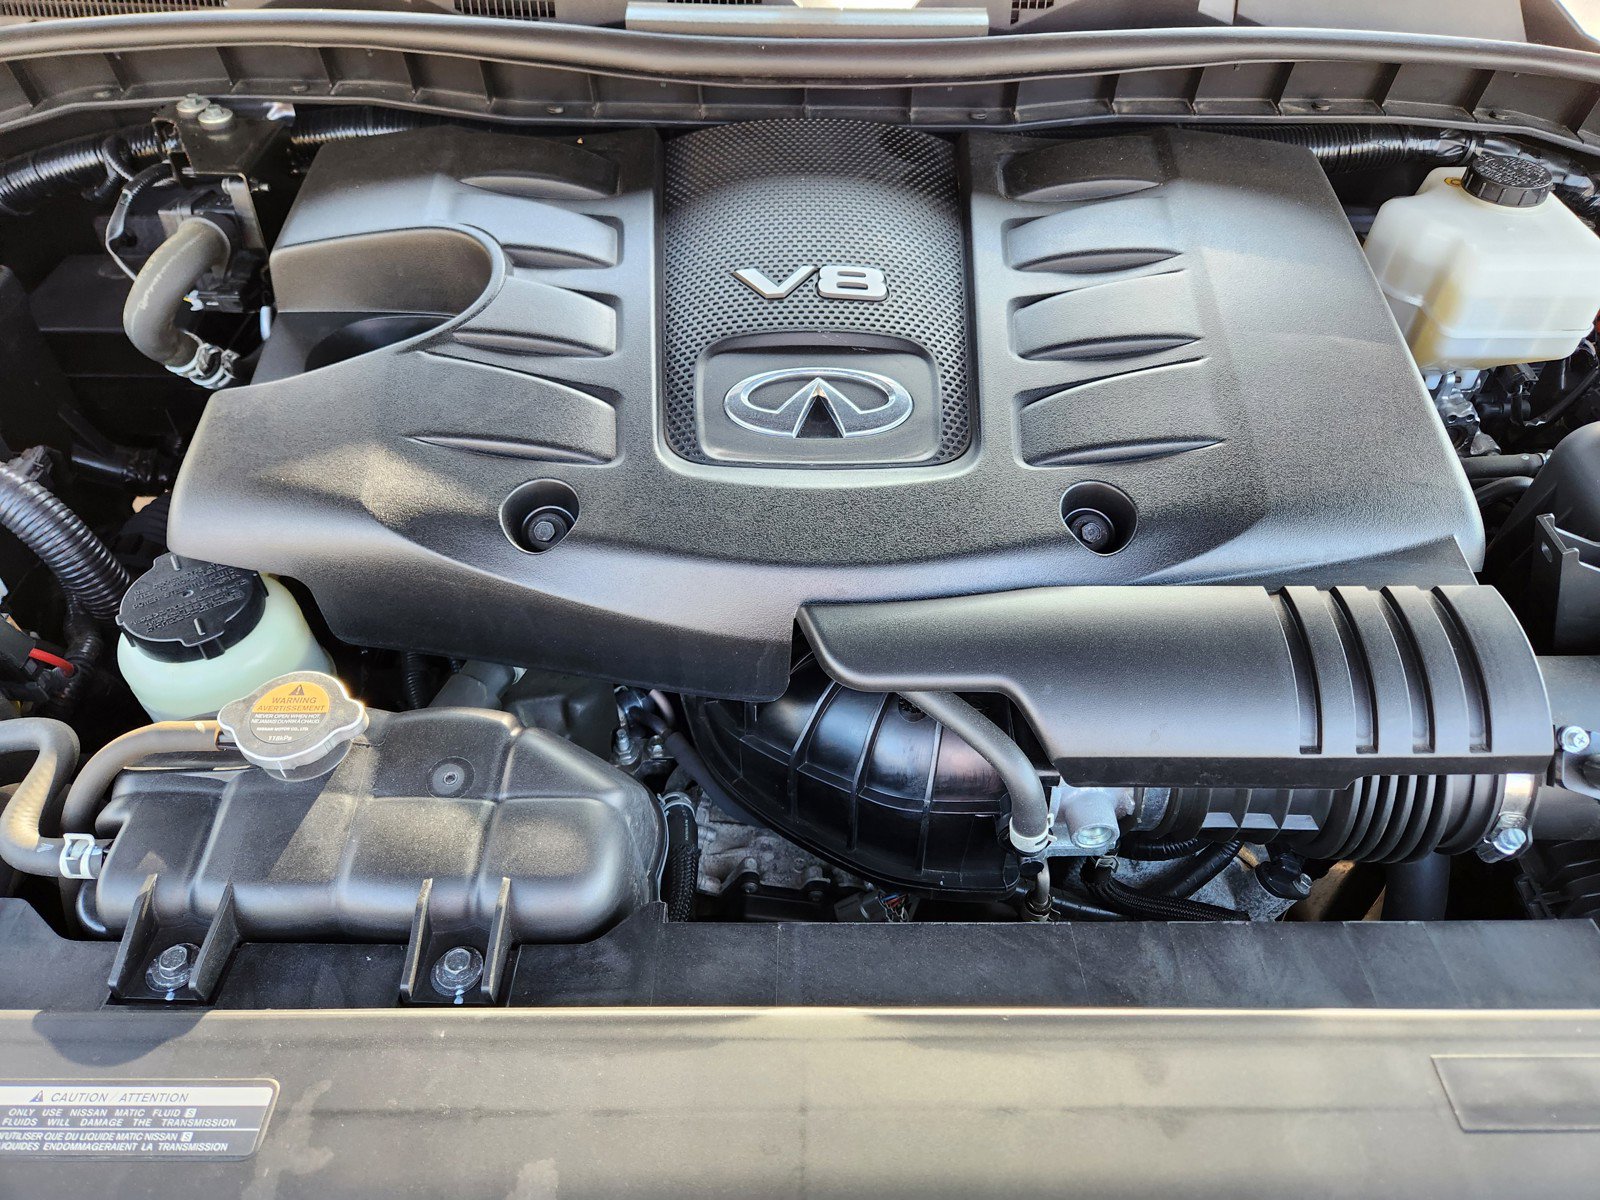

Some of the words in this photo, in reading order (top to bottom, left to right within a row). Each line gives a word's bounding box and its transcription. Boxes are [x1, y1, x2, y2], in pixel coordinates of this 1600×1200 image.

[731, 264, 889, 301] V8
[133, 596, 160, 609] POWER
[272, 696, 317, 704] WARNING
[51, 1092, 108, 1102] CAUTION
[118, 1092, 189, 1102] ATTENTION
[9, 1108, 35, 1116] ONLY
[42, 1108, 63, 1116] USE
[69, 1108, 108, 1116] NISSAN
[114, 1108, 145, 1117] MATIC
[152, 1108, 181, 1117] FLUID
[2, 1118, 38, 1126] FLUIDS
[47, 1118, 71, 1126] WILL
[80, 1118, 124, 1127] DAMAGE
[133, 1118, 152, 1127] THE
[161, 1118, 237, 1127] TRANSMISSION
[43, 1132, 65, 1141] QUE
[65, 1132, 80, 1141] DU
[80, 1132, 116, 1141] LIQUIDE
[116, 1132, 144, 1141] MATIC
[144, 1132, 178, 1141] NISSAN
[0, 1142, 40, 1151] IQUIDES
[42, 1142, 138, 1151] ENDOMMAGERAIENT
[140, 1142, 153, 1151] LA
[158, 1142, 228, 1152] TRANSMISSION
